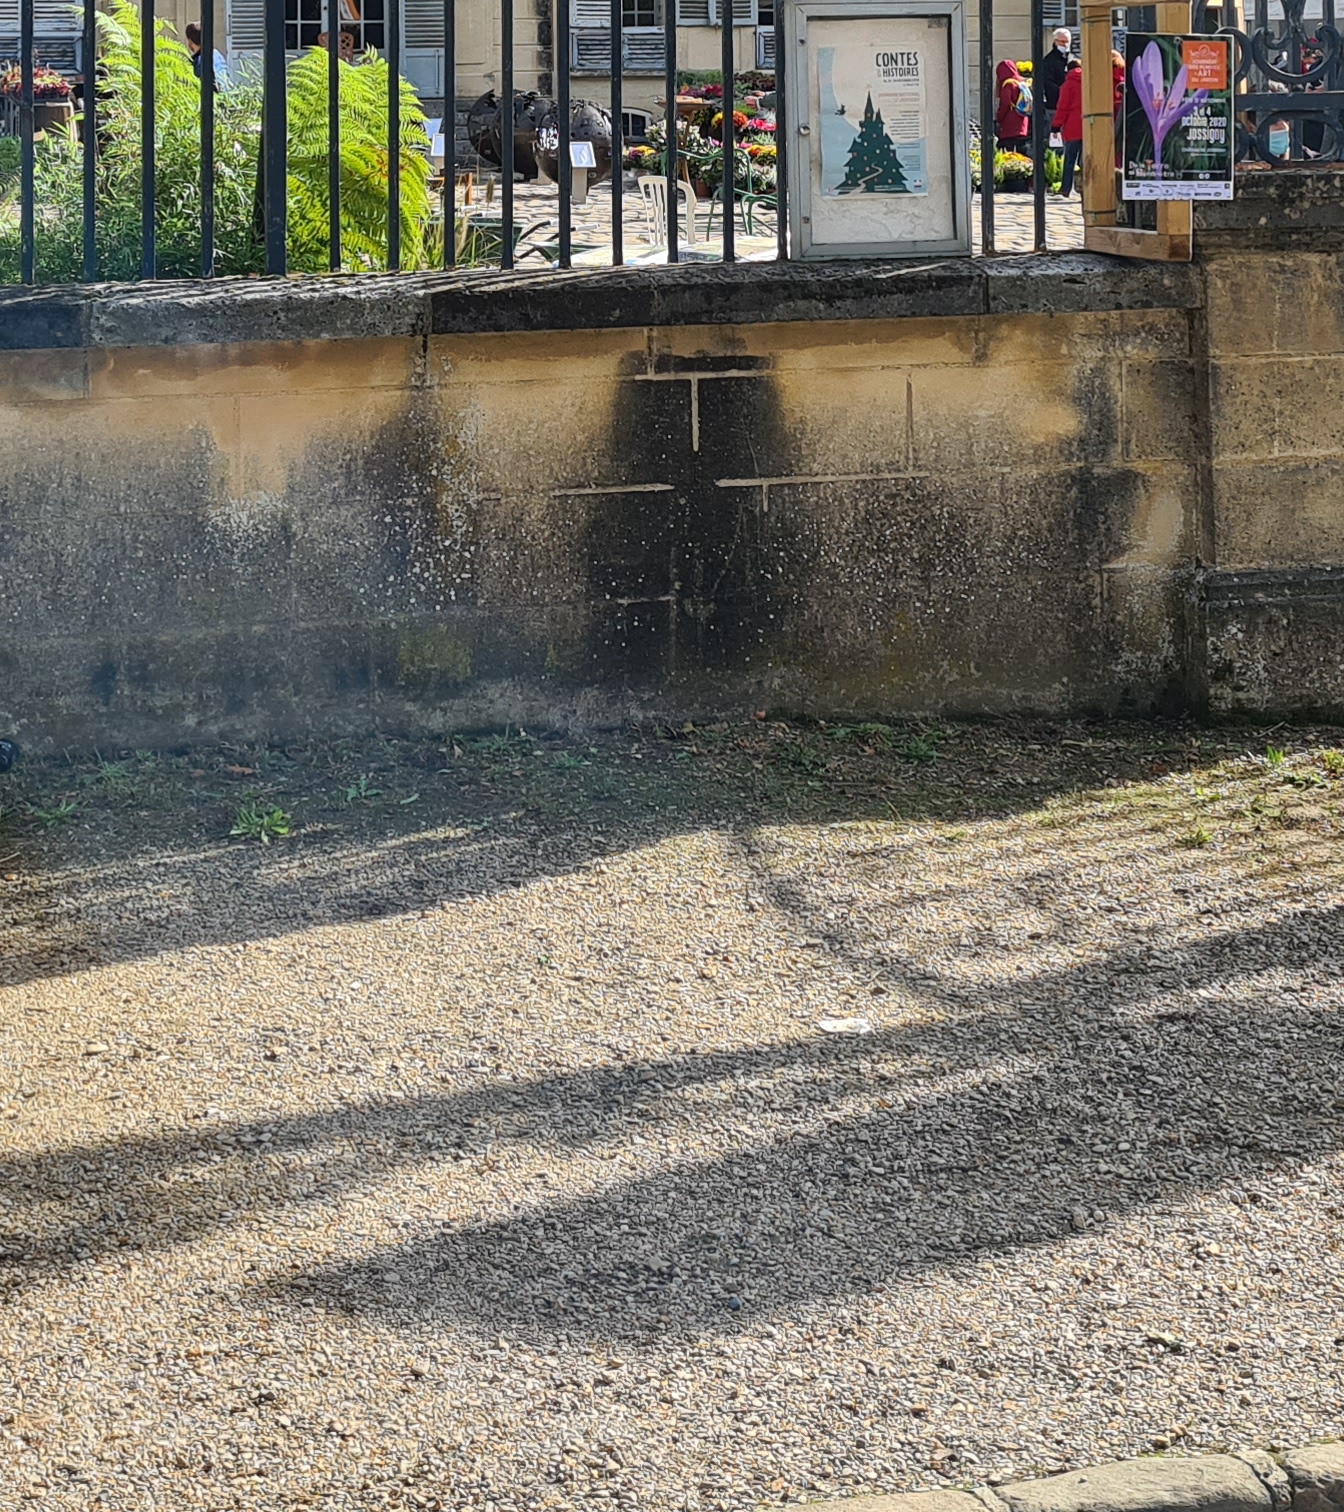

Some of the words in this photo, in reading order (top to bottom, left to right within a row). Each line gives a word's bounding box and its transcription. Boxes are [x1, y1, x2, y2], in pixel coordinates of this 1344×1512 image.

[875, 51, 919, 67] CONTES
[882, 66, 919, 78] HISTOIRES
[1206, 106, 1212, 116] 4
[1209, 116, 1227, 127] 2020
[1186, 125, 1225, 144] Jossigny
